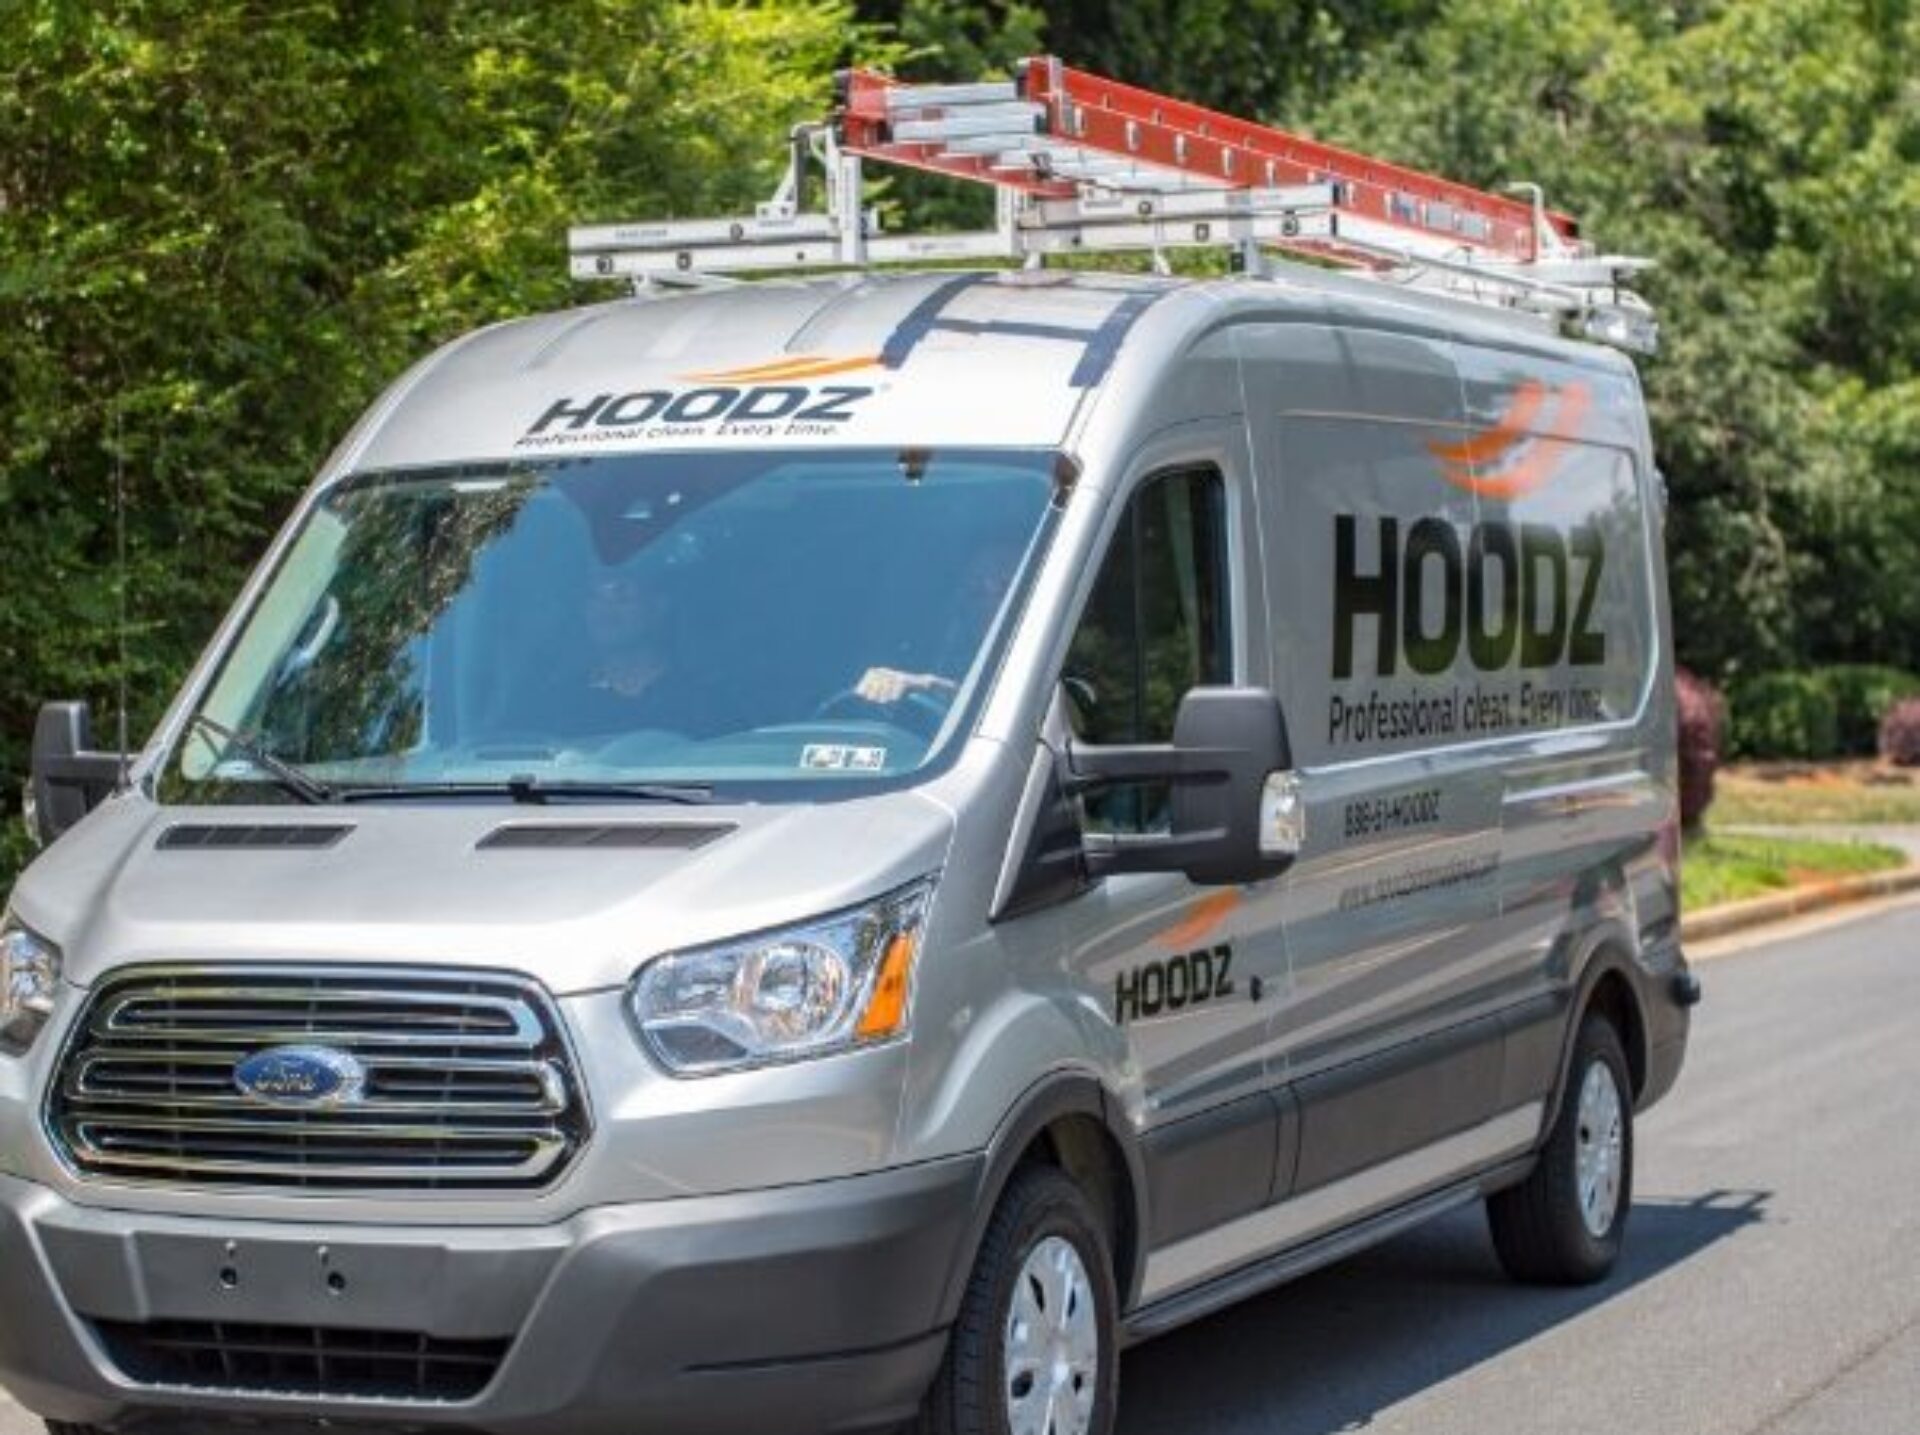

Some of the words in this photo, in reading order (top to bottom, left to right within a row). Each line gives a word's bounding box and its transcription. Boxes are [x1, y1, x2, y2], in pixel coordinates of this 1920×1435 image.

[526, 386, 873, 436] HOODZ
[1332, 514, 1605, 679] HOODZ
[1328, 684, 1459, 743] Professional
[1115, 943, 1234, 1025] HOODZ
